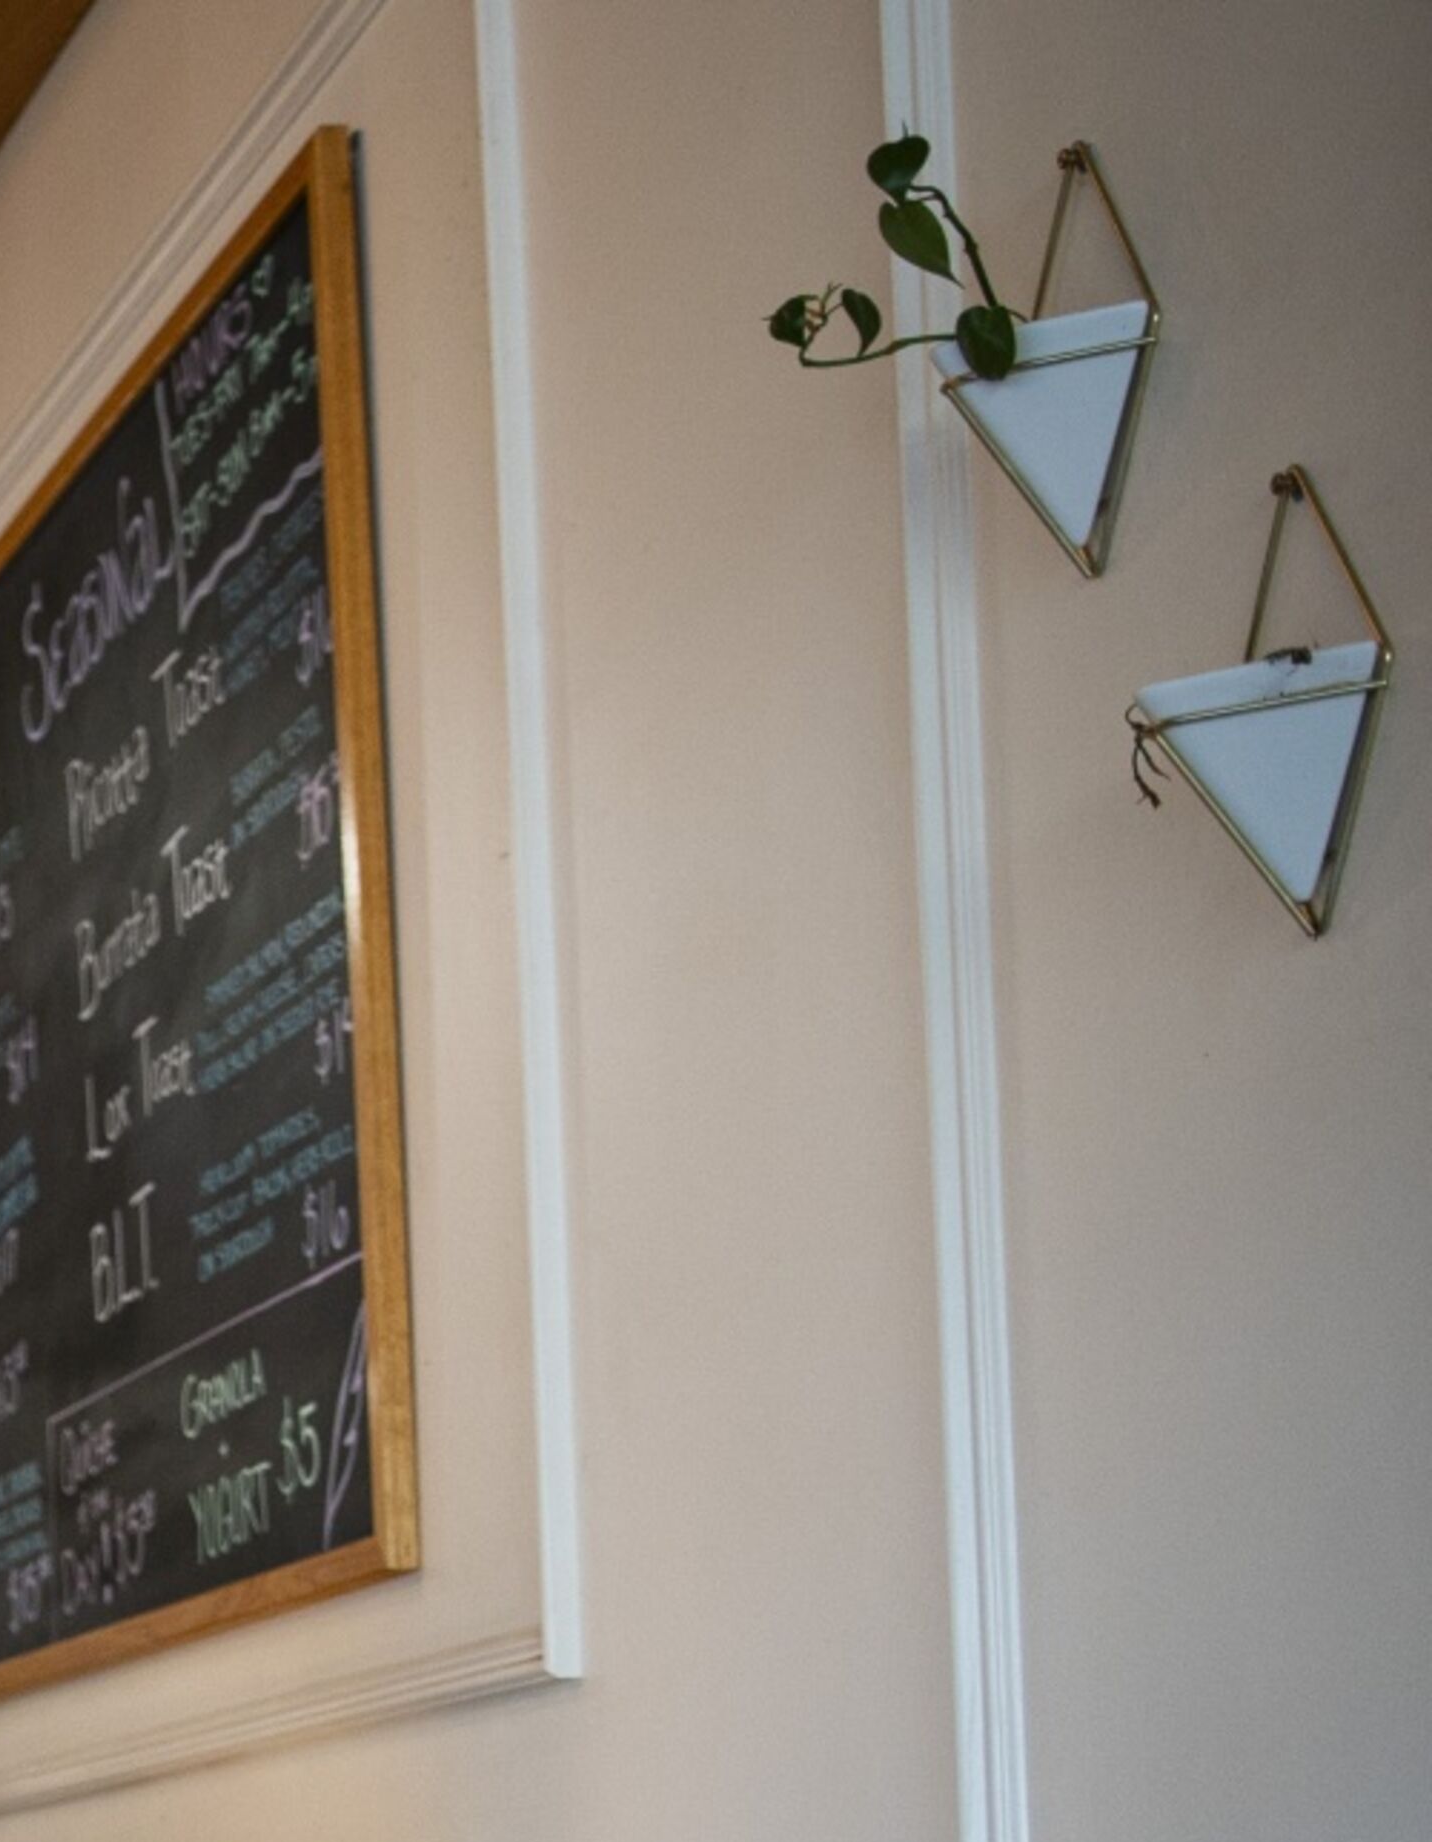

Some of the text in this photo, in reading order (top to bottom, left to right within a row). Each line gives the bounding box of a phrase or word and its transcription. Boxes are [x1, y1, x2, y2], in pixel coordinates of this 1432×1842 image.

[151, 649, 225, 747] Toast
[160, 826, 230, 934] Toast
[86, 1078, 131, 1162] Lox
[132, 1016, 196, 1115] Toast
[90, 1182, 159, 1322] BLT
[181, 1349, 266, 1439] GRANOLA
[189, 1397, 320, 1563] YOGURT $5
